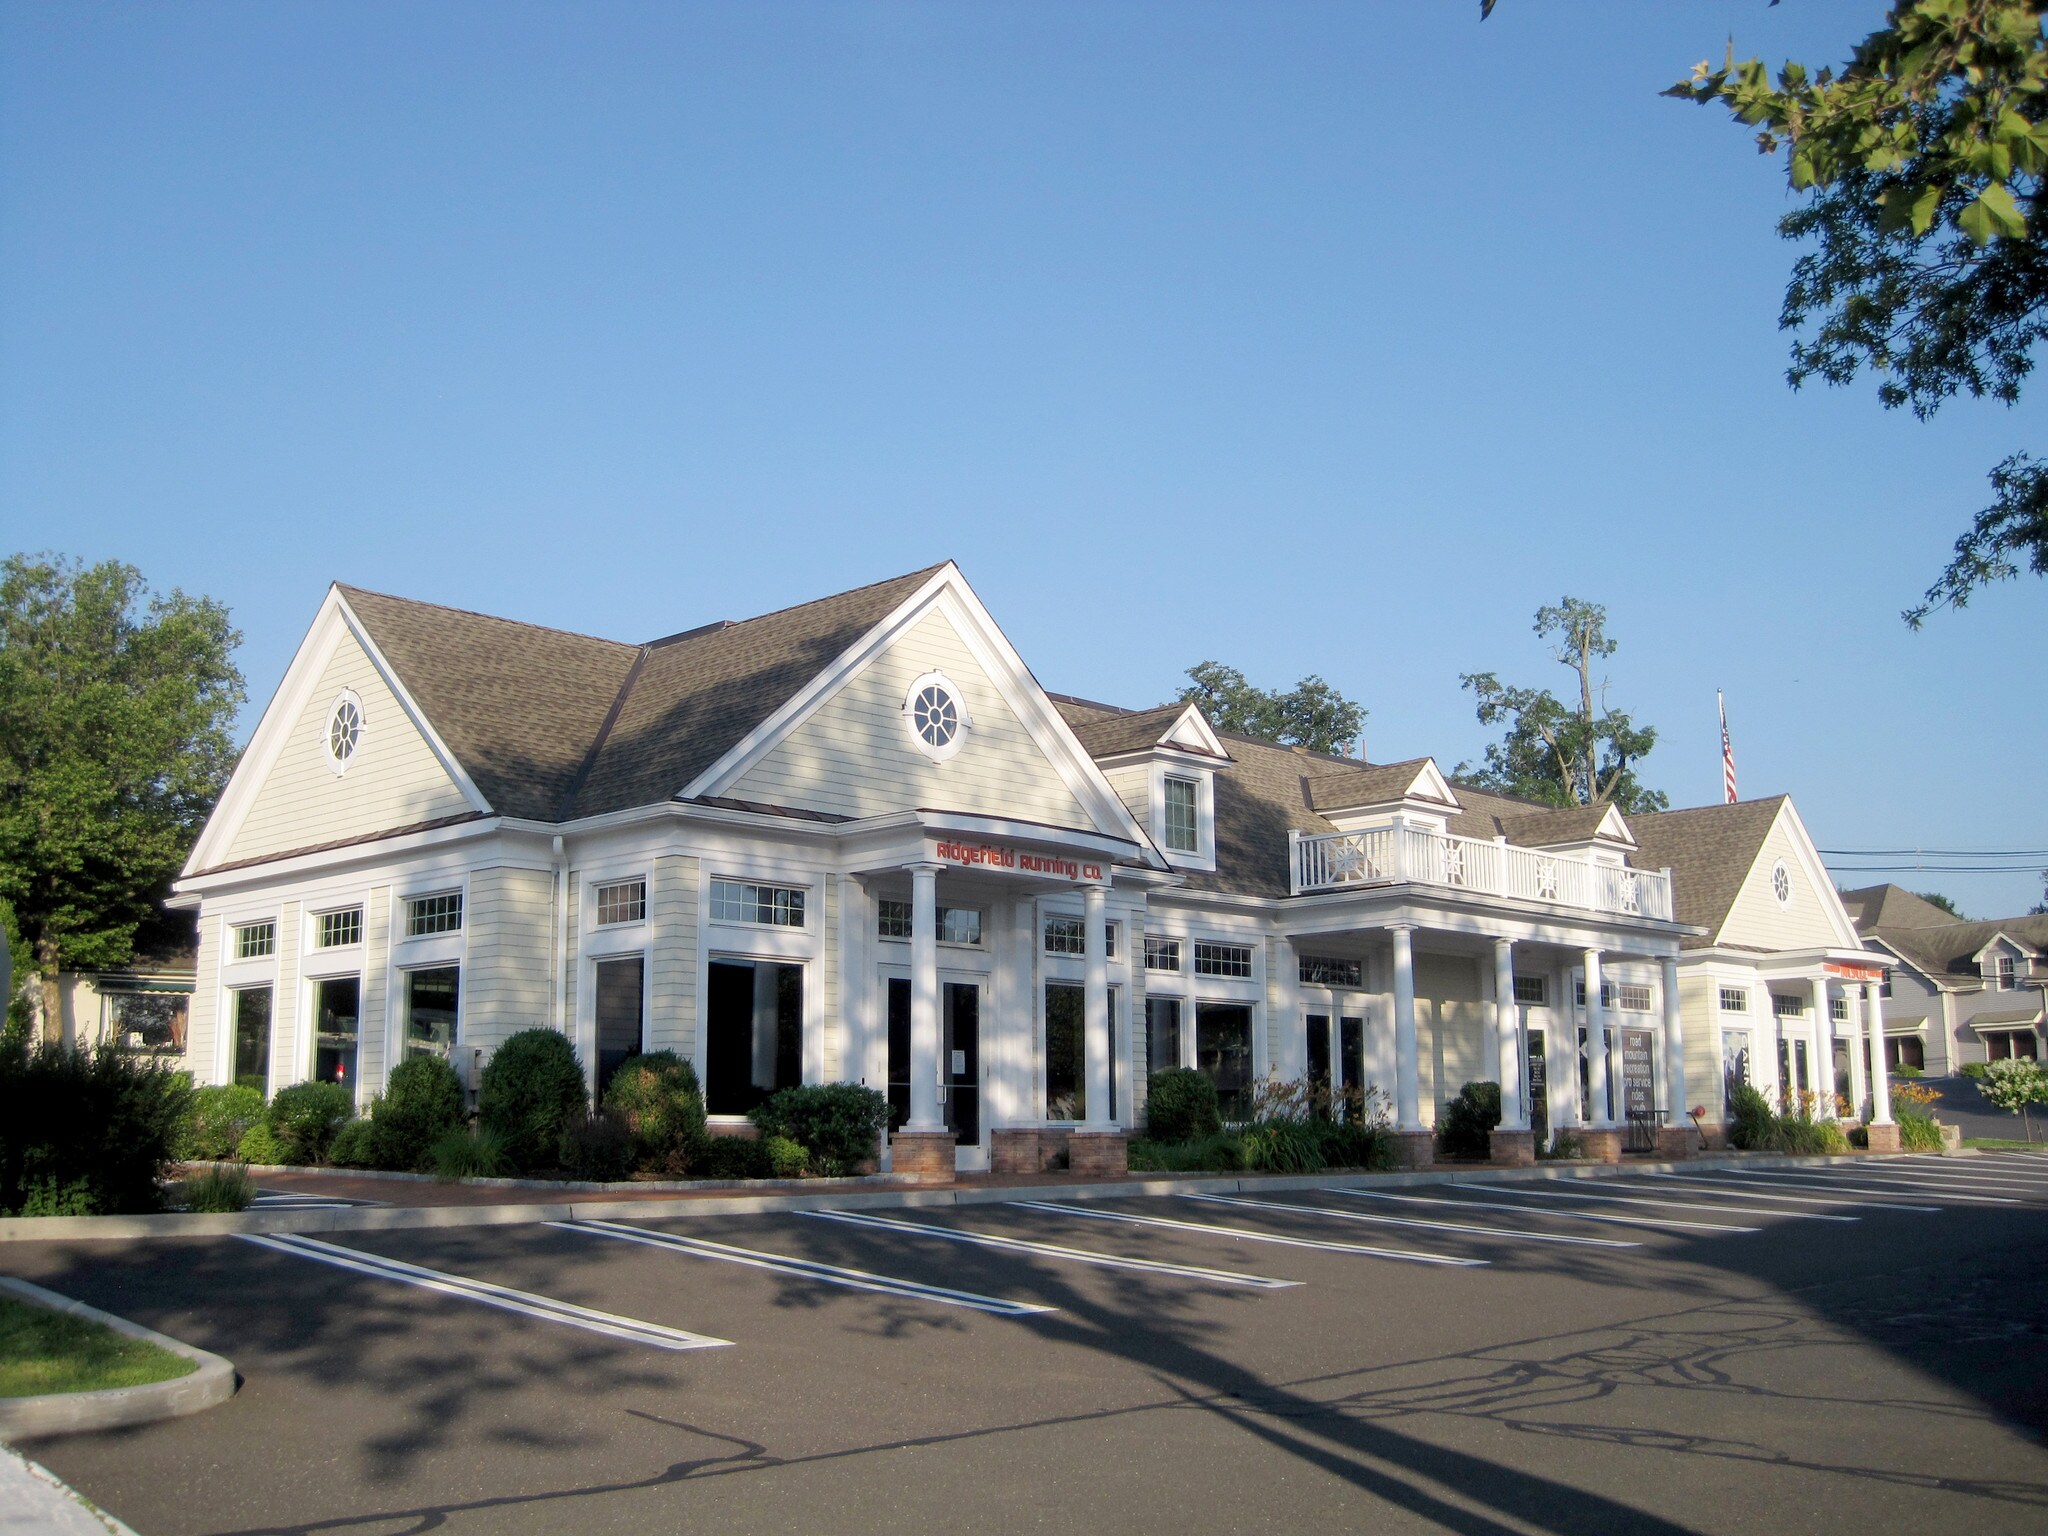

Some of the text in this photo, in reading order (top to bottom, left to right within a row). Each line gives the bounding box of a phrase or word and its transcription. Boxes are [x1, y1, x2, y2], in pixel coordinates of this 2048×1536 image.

[936, 841, 1015, 868] Ridgefield
[1019, 853, 1078, 880] Running
[1629, 1034, 1642, 1047] road
[1624, 1048, 1648, 1060] mountain
[1623, 1062, 1650, 1074] recreation
[1633, 1075, 1652, 1088] service
